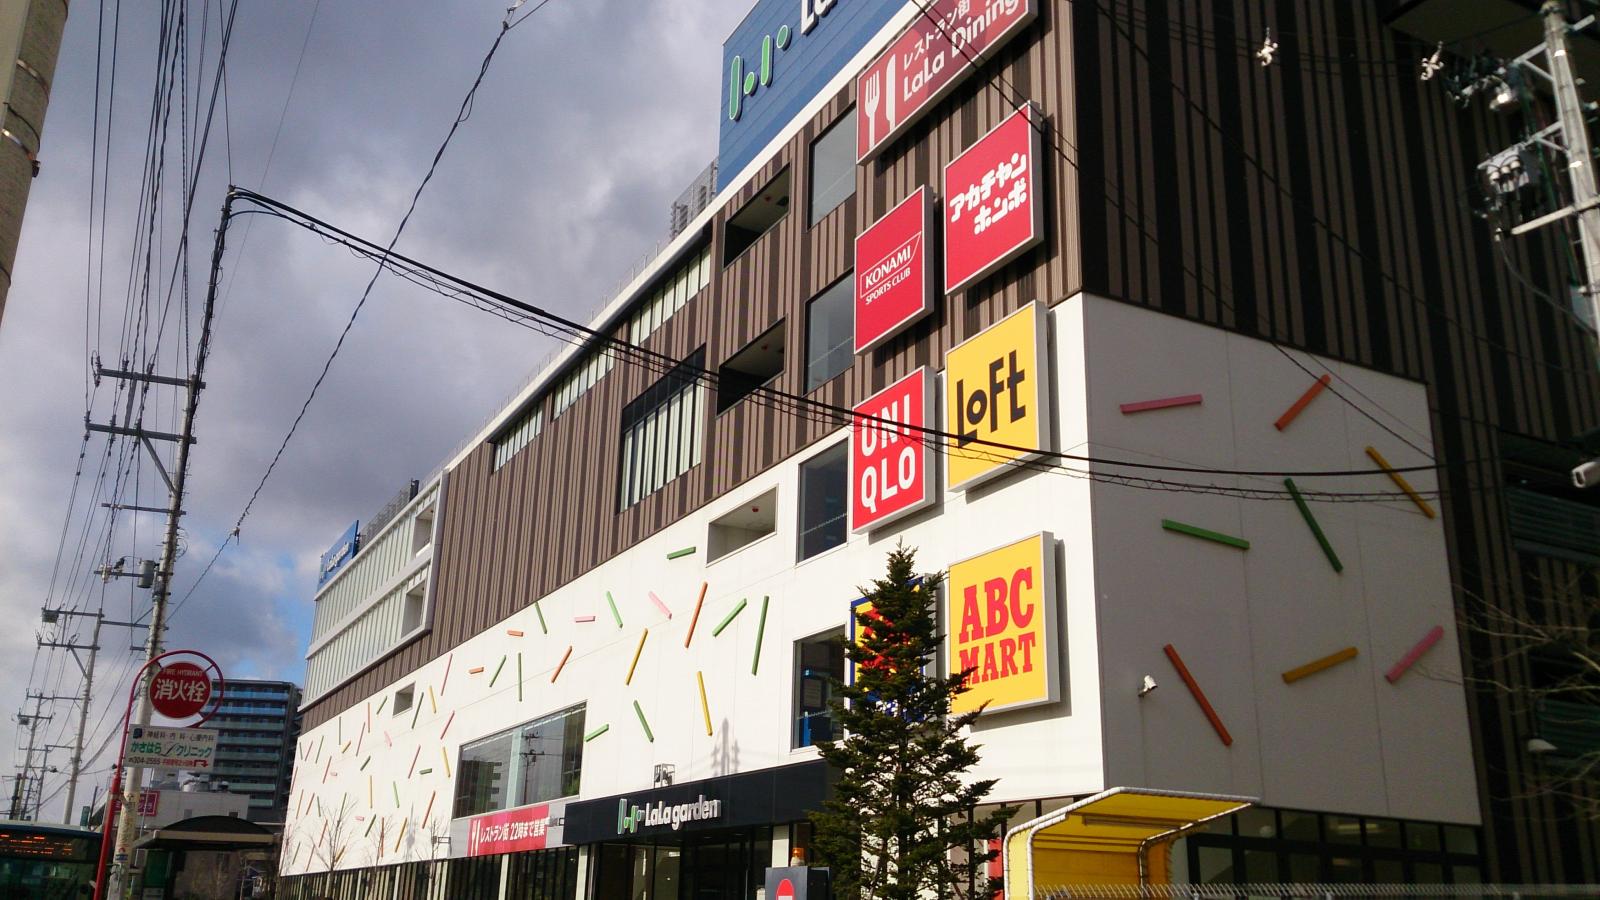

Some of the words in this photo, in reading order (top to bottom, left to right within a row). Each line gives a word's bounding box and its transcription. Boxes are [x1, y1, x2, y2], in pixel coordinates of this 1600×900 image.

[903, 51, 945, 102] LaLa
[951, 0, 1019, 58] Dining
[950, 153, 1027, 223] アカチャン
[865, 245, 911, 289] KONAMI
[865, 281, 892, 305] SPORTS
[892, 267, 911, 286] CLUB
[861, 394, 911, 457] UNI
[861, 446, 916, 513] QLO
[959, 567, 1034, 644] ABC
[959, 632, 1036, 685] MART
[154, 679, 207, 703] 消火栓
